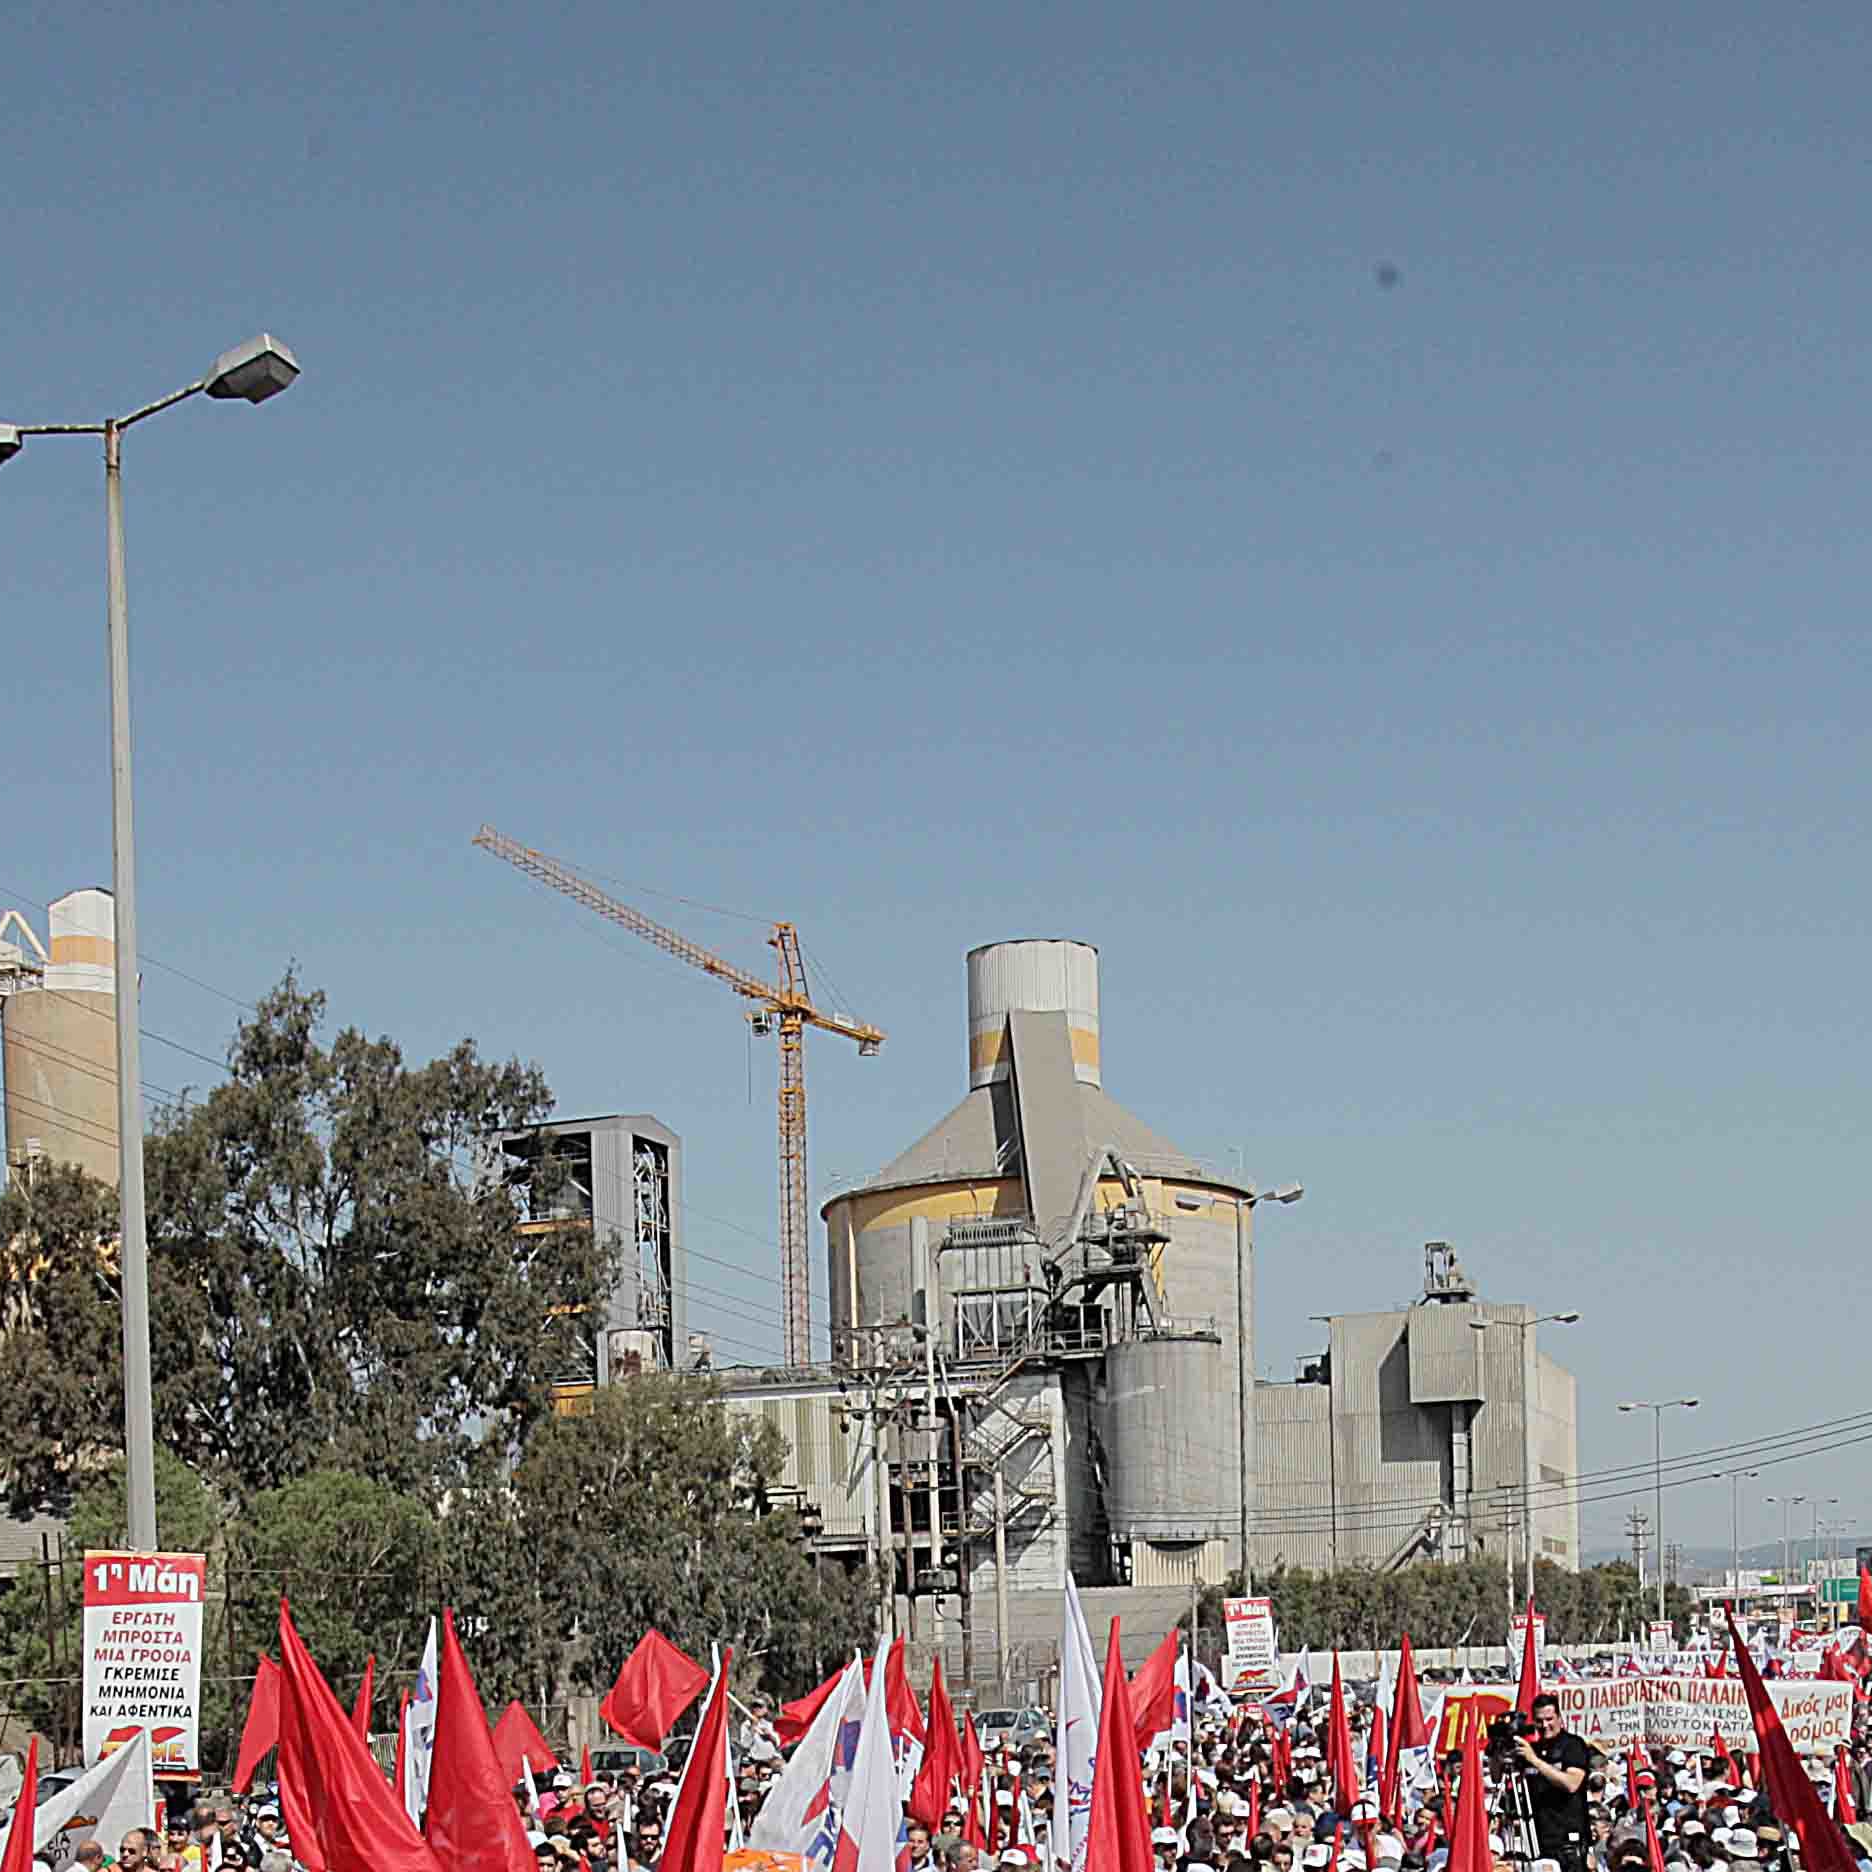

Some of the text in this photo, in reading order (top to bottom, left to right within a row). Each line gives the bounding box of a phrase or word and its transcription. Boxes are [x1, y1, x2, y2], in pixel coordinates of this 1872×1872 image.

[128, 1563, 199, 1602] Μάη
[111, 1611, 176, 1626] ΕΡΓΑΤΗ
[103, 1629, 184, 1645] ΜΠΡΟΣΤΑ
[93, 1648, 192, 1664] ΜΙΑ ΓΡΟΘΙΑ
[103, 1667, 181, 1682] ΓΚΡΕΜΙΣΕ
[98, 1685, 185, 1701] ΜΝΗΜΟΝΙΑ
[89, 1704, 193, 1719] ΚΑΙ ΑΦΕΝΤΙΚΑ
